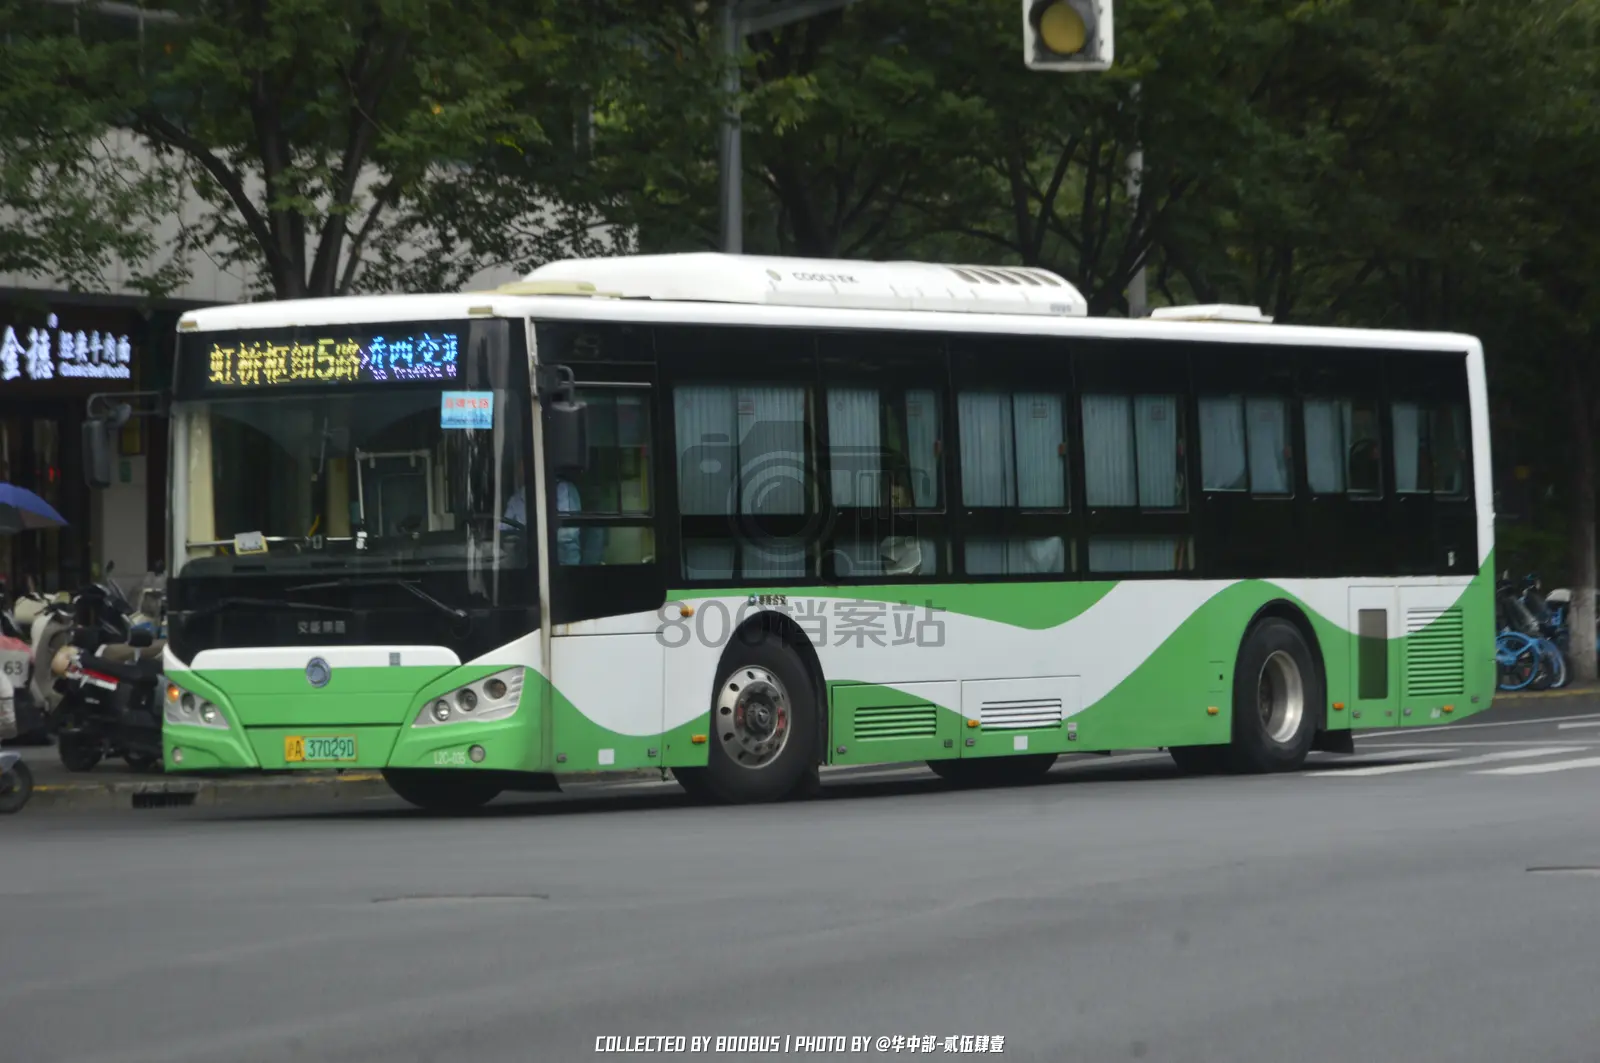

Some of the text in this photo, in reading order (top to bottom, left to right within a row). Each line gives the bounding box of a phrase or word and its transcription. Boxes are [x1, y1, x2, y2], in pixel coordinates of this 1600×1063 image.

[792, 272, 859, 284] COOLTEK
[207, 337, 361, 385] 虹桥枢纽5路
[3, 660, 23, 676] 63
